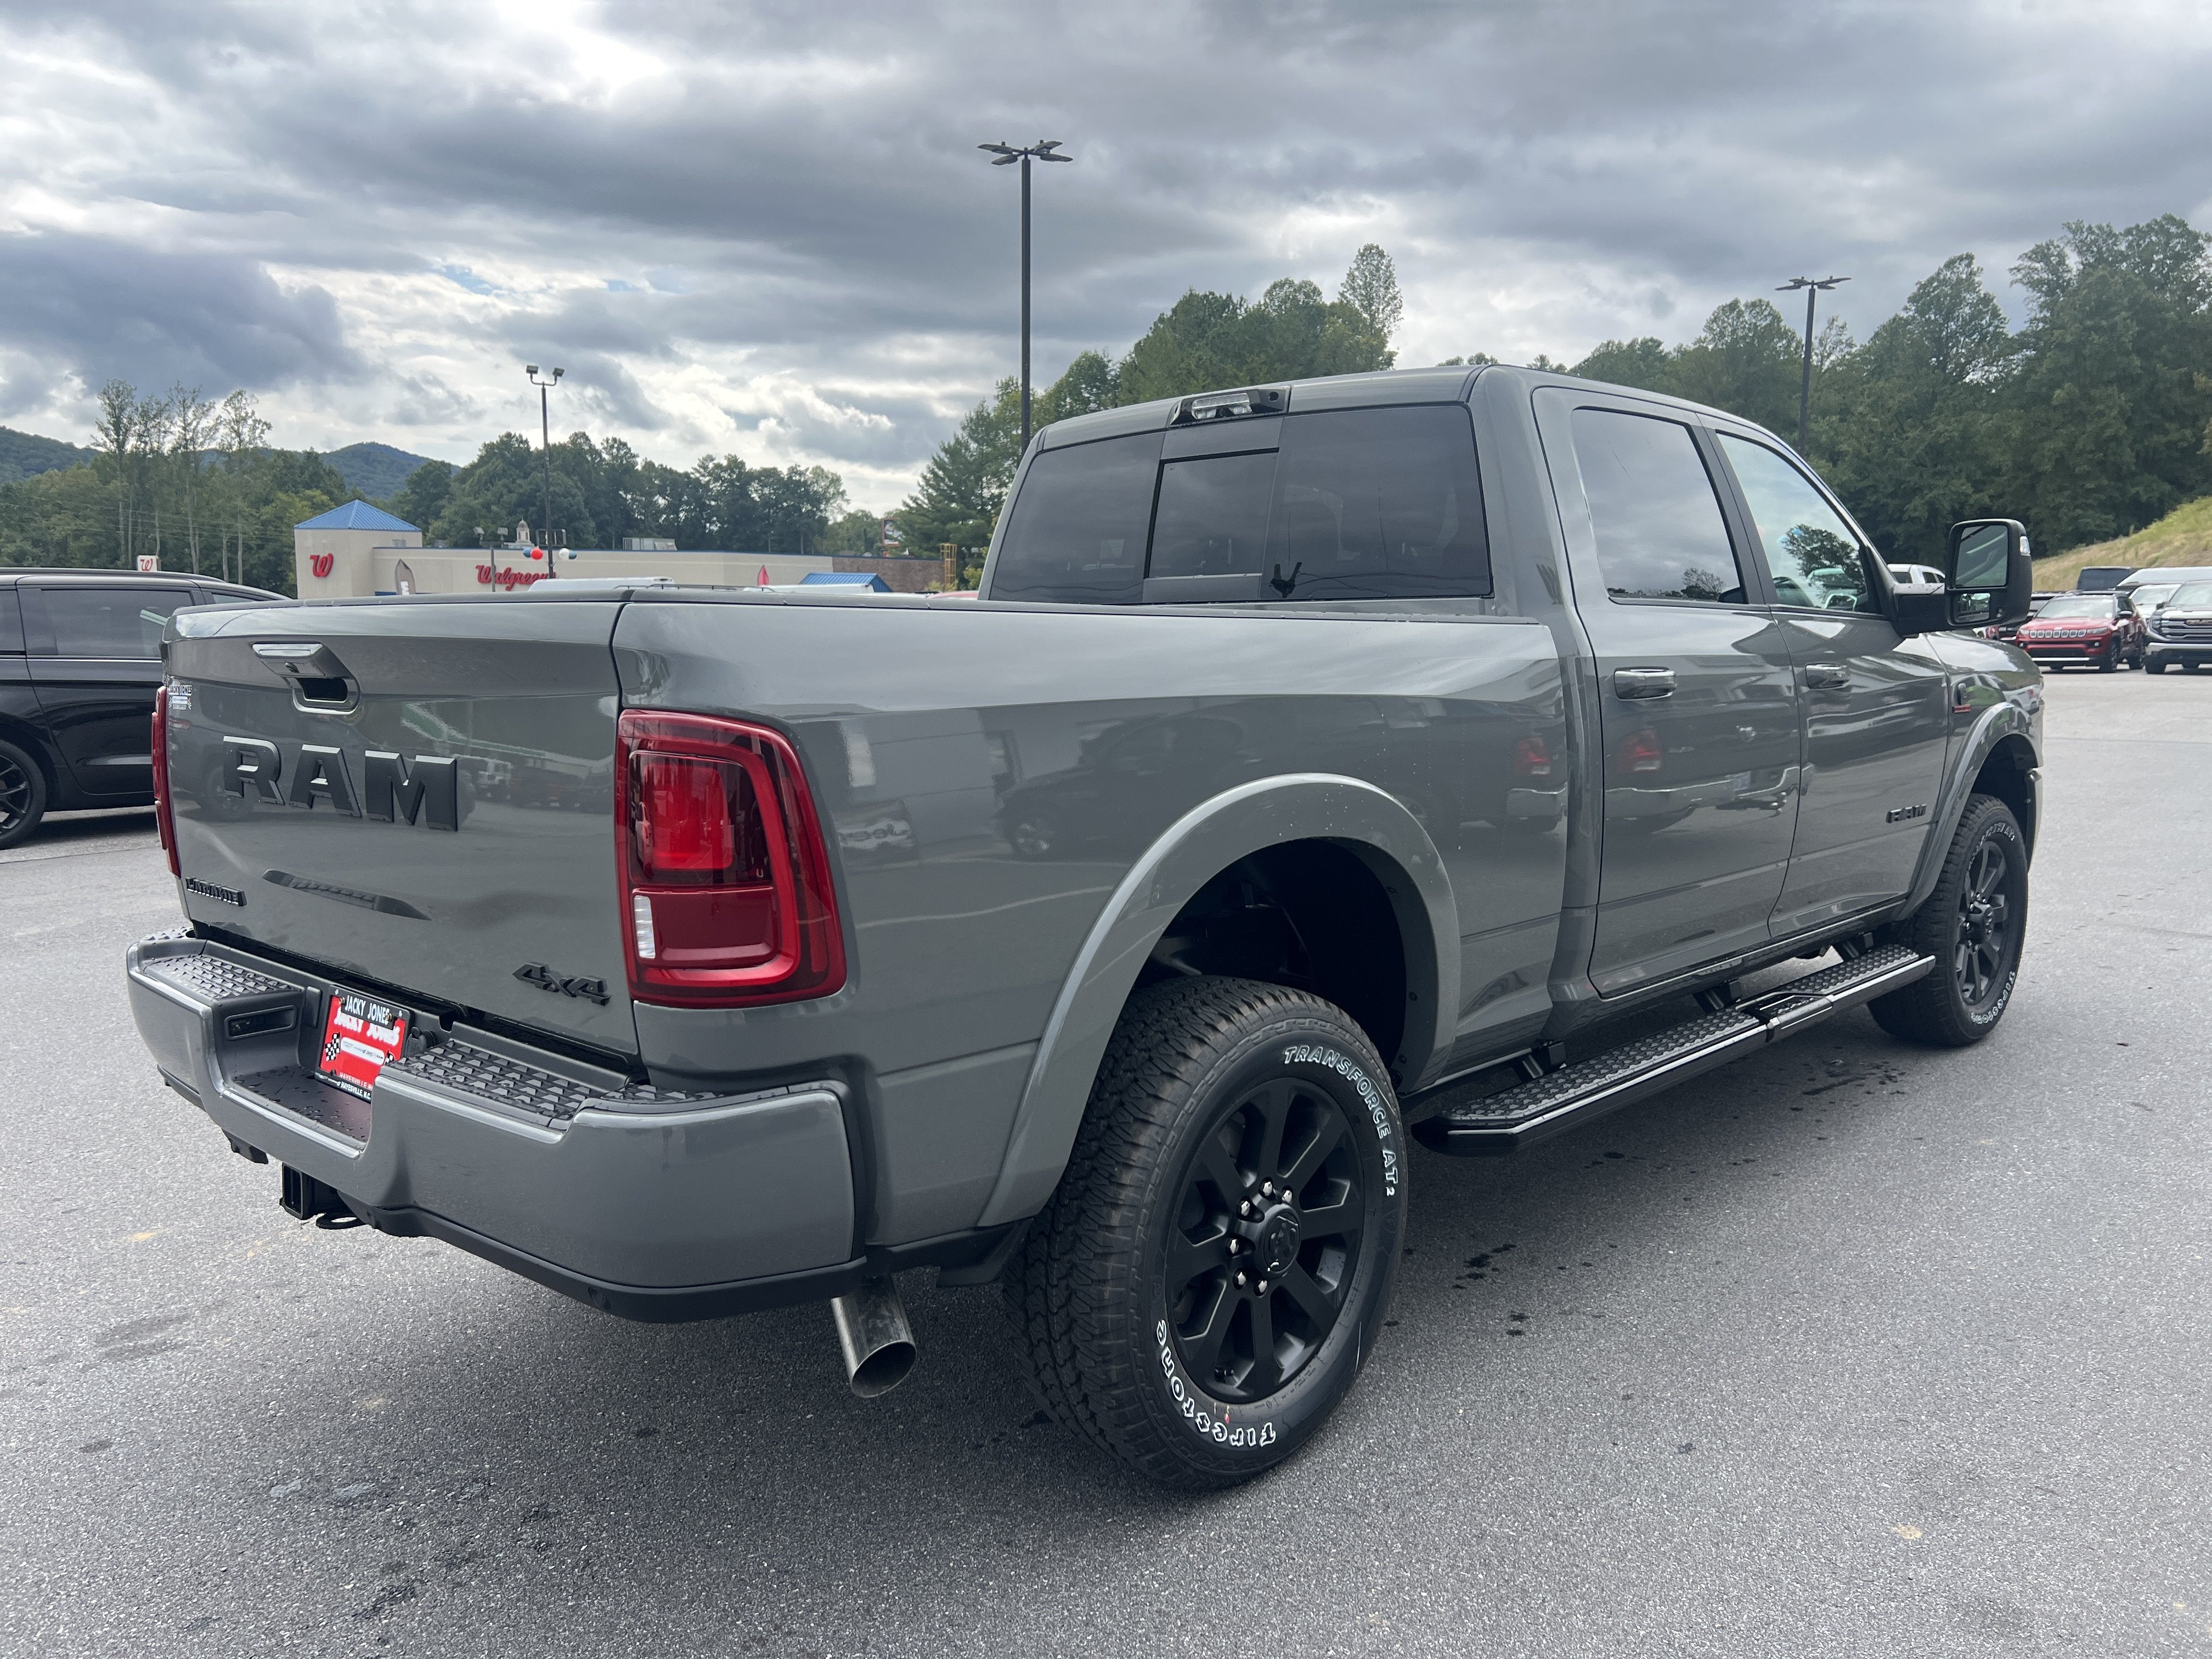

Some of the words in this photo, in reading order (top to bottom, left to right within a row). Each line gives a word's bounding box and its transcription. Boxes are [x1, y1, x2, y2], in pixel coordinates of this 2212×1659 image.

[140, 558, 153, 572] W
[309, 553, 334, 578] W
[222, 735, 458, 832] RAM
[1886, 803, 1927, 824] RAM
[185, 876, 248, 907] LARAMIE
[345, 995, 366, 1017] JACKY
[367, 1002, 391, 1025] JONES
[1283, 1045, 1391, 1139] TRANSFORCE
[1156, 1319, 1276, 1447] Firestone
